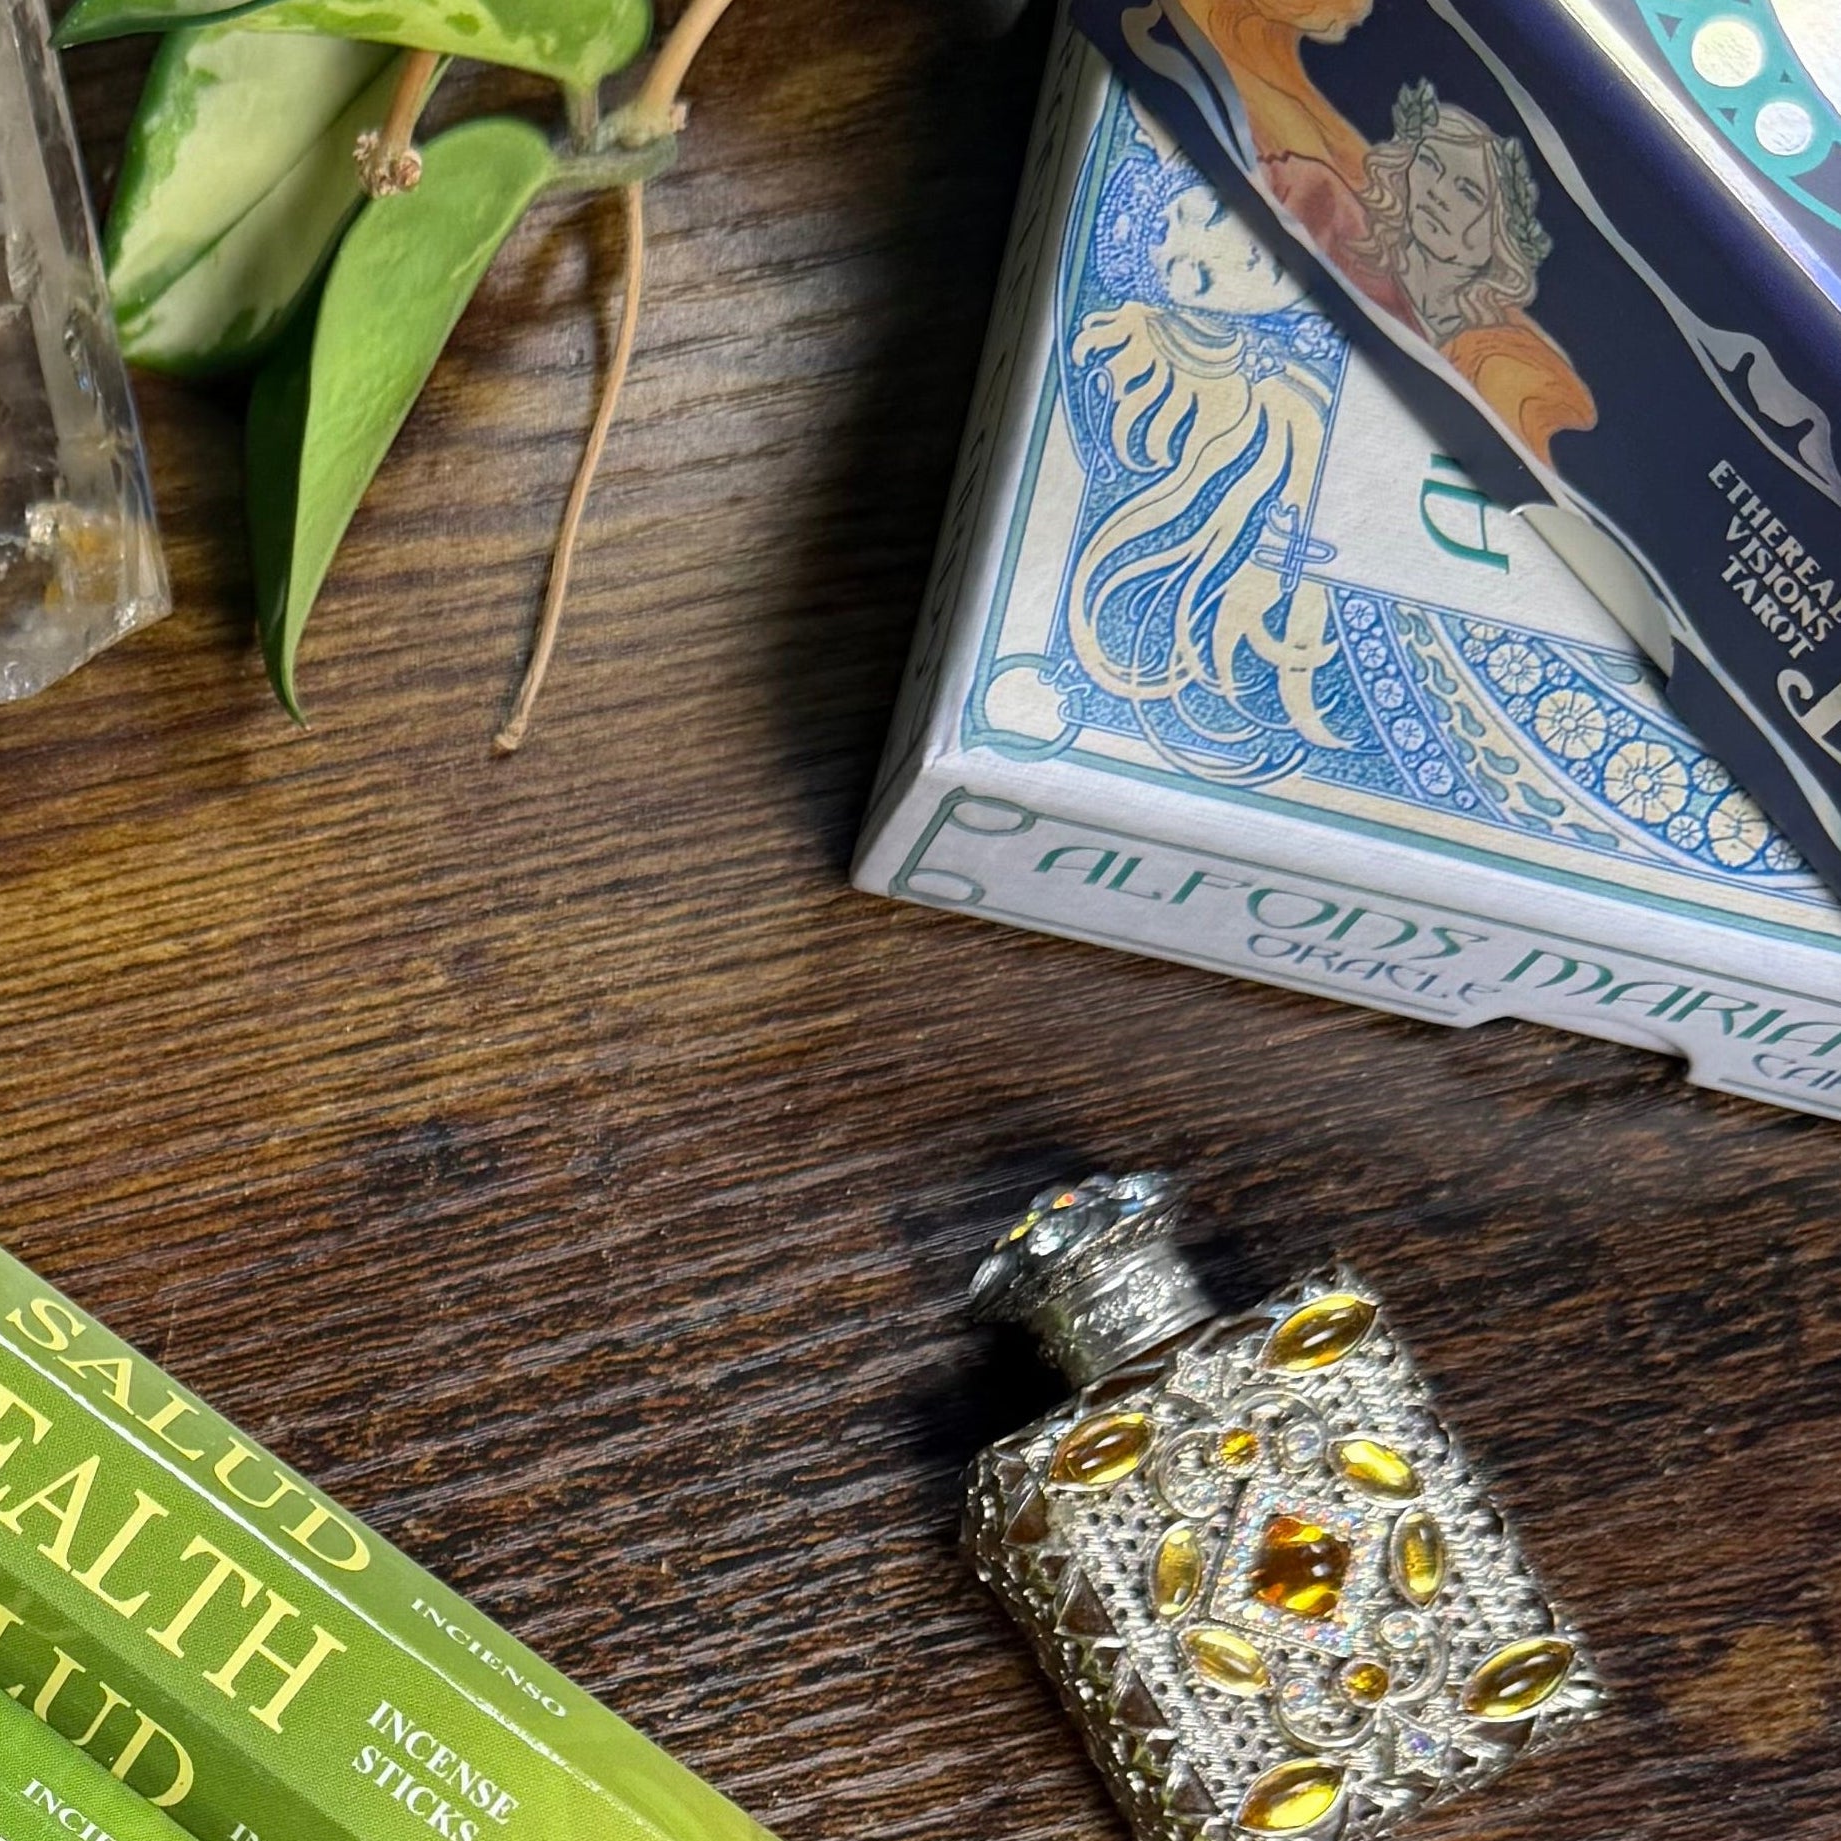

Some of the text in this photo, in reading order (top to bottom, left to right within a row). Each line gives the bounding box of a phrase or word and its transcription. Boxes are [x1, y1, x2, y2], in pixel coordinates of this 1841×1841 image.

[1707, 458, 1841, 624] ETHEREAL
[1725, 514, 1834, 642] VISIONS
[1721, 554, 1815, 660] TAROT
[1033, 845, 1841, 1057] ALFONS MARIA
[1247, 933, 1502, 1006] ORACLE
[5, 1298, 371, 1572] SALUD
[411, 1597, 569, 1718] INCIENSO
[365, 1700, 521, 1826] INCENSE
